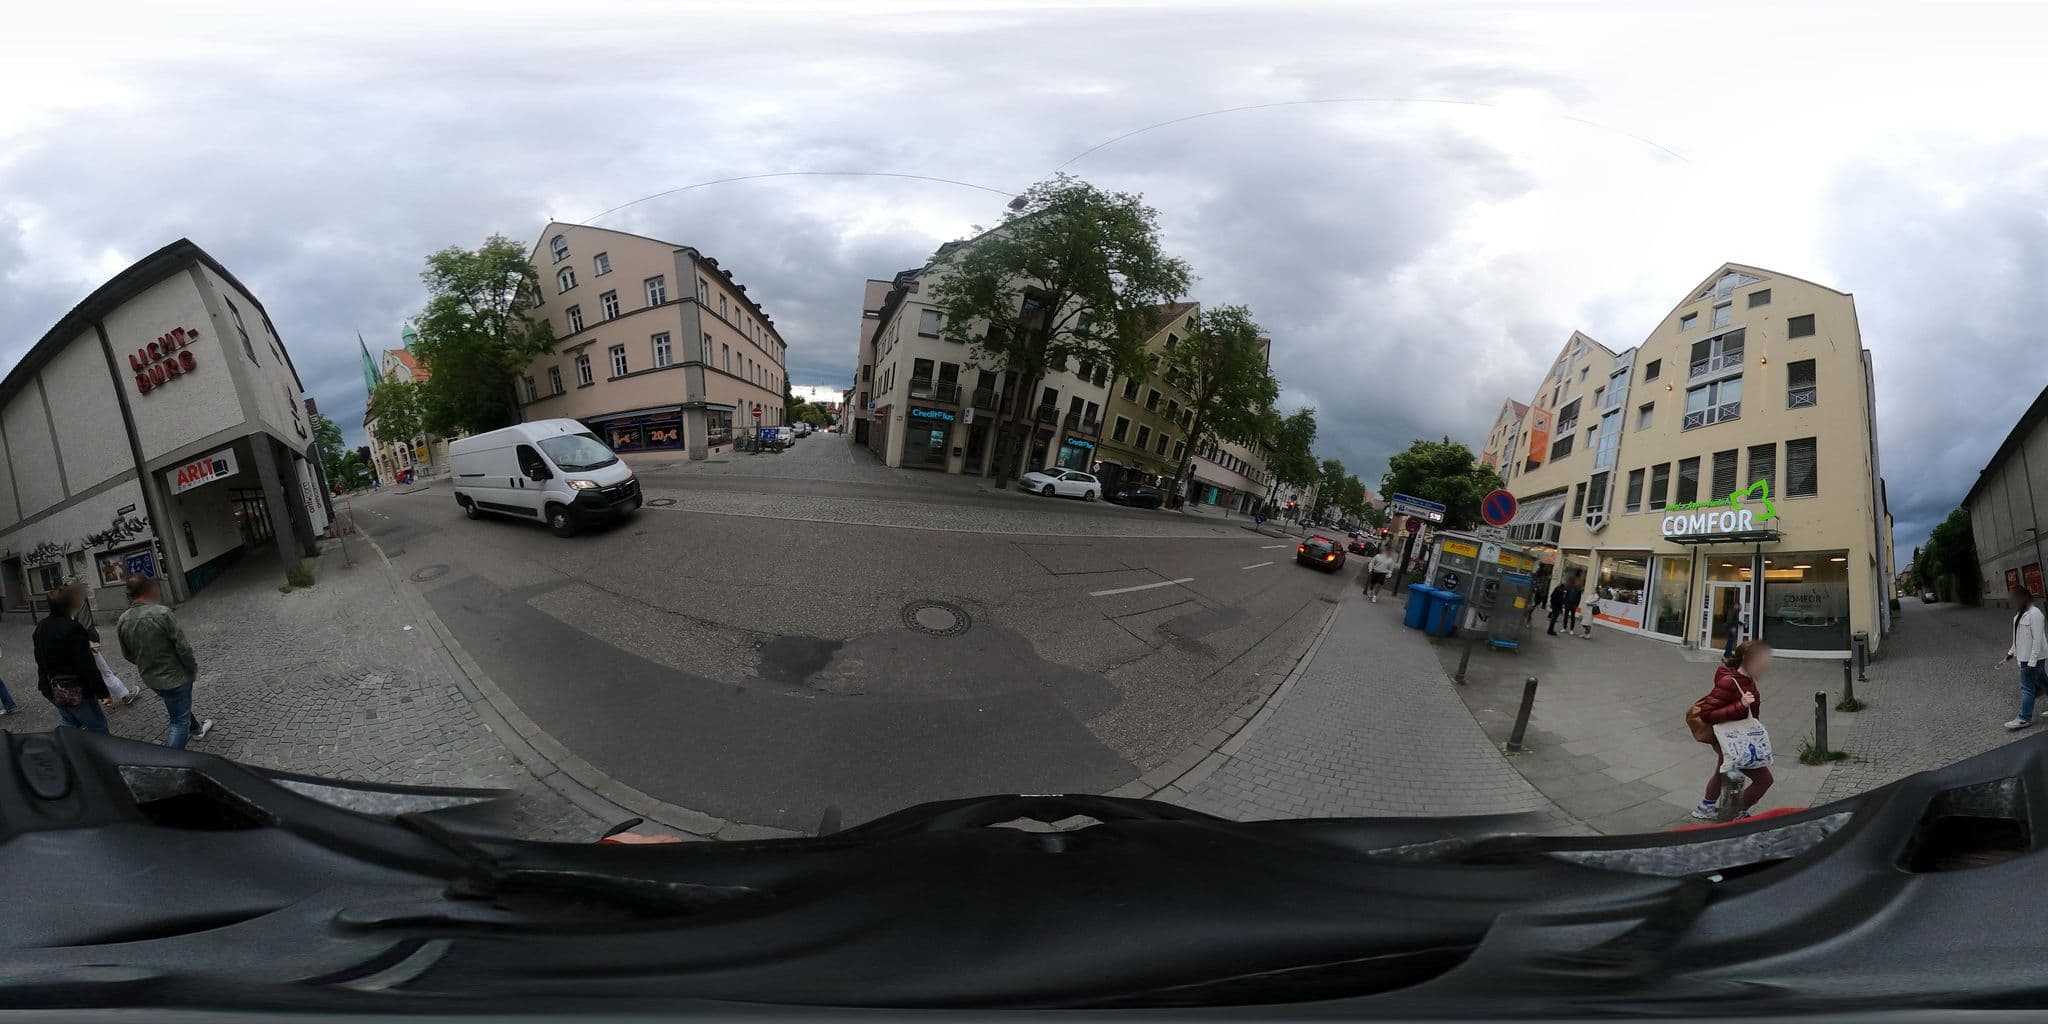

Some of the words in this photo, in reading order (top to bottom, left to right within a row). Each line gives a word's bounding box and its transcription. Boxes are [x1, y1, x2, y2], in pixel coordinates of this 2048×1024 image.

[128, 327, 198, 373] LICHT-
[135, 351, 197, 395] BURG
[177, 456, 213, 487] ARLT
[1662, 509, 1753, 535] COMFOR
